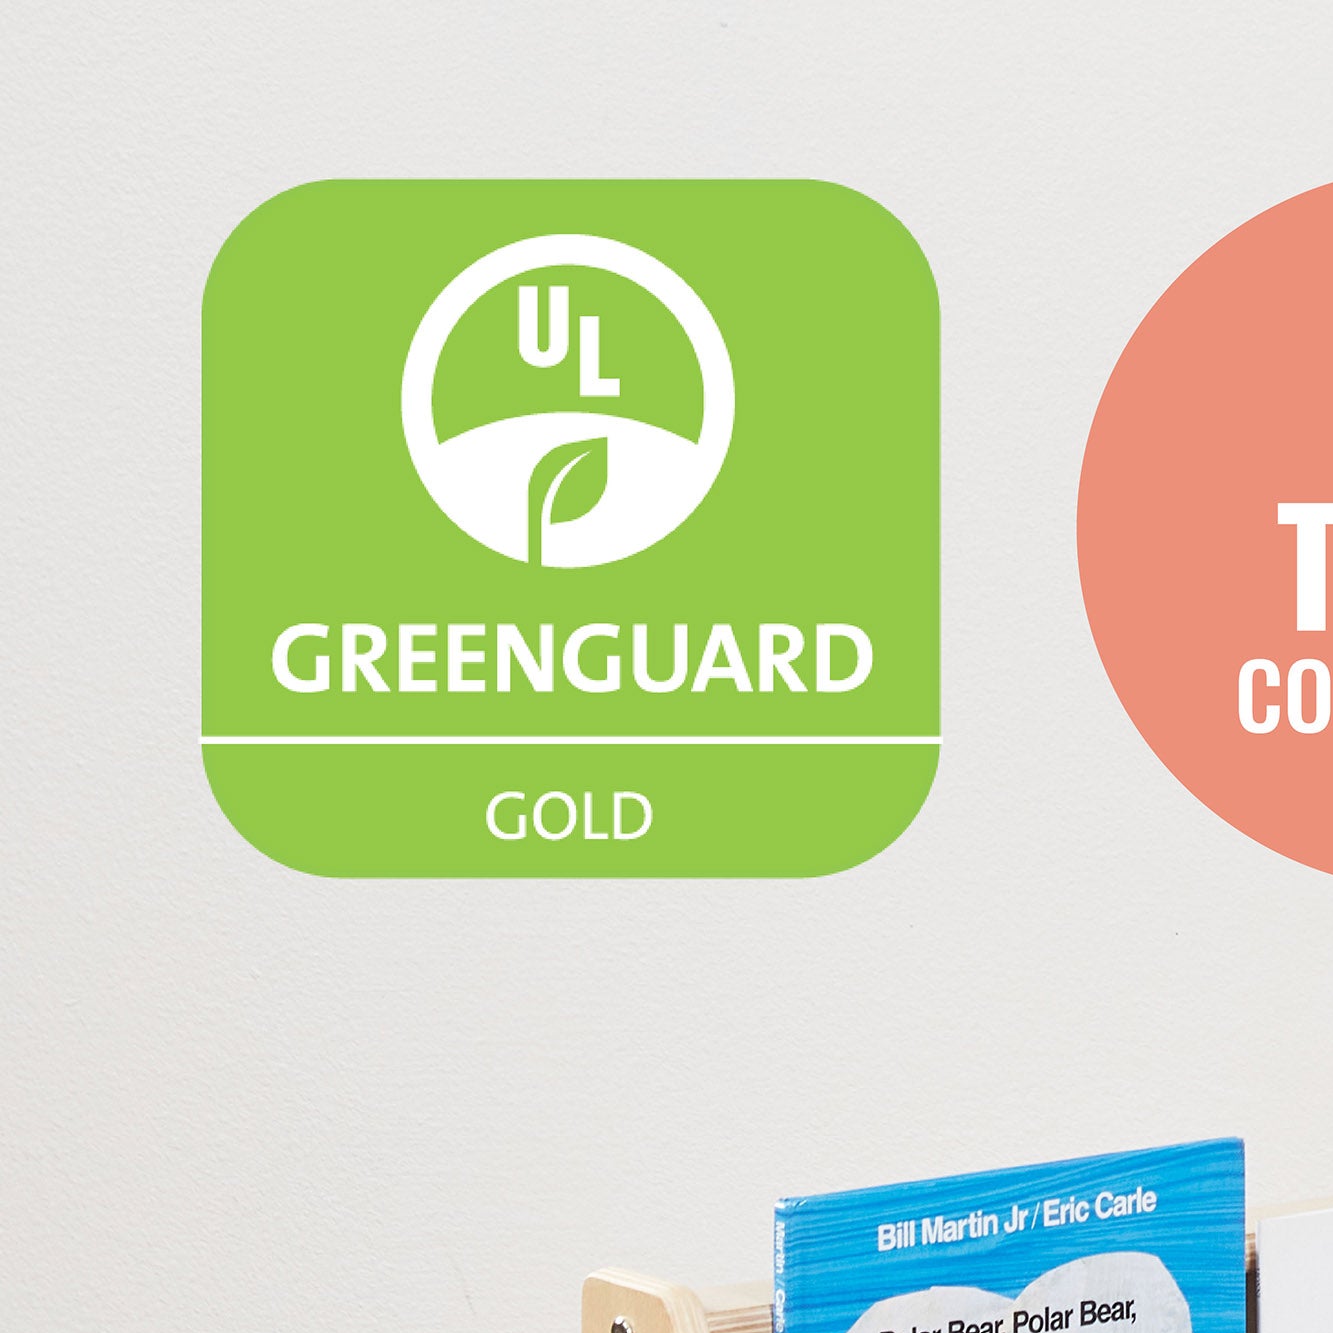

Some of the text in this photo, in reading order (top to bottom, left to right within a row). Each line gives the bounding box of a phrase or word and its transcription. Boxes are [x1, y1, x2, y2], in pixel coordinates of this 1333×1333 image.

[877, 1219, 916, 1252] Bill
[921, 1209, 999, 1246] Martin
[1043, 1195, 1090, 1228] Eric
[1095, 1186, 1158, 1220] Carle
[775, 1221, 787, 1333] Martin Carle
[1080, 1299, 1137, 1326] Bear,
